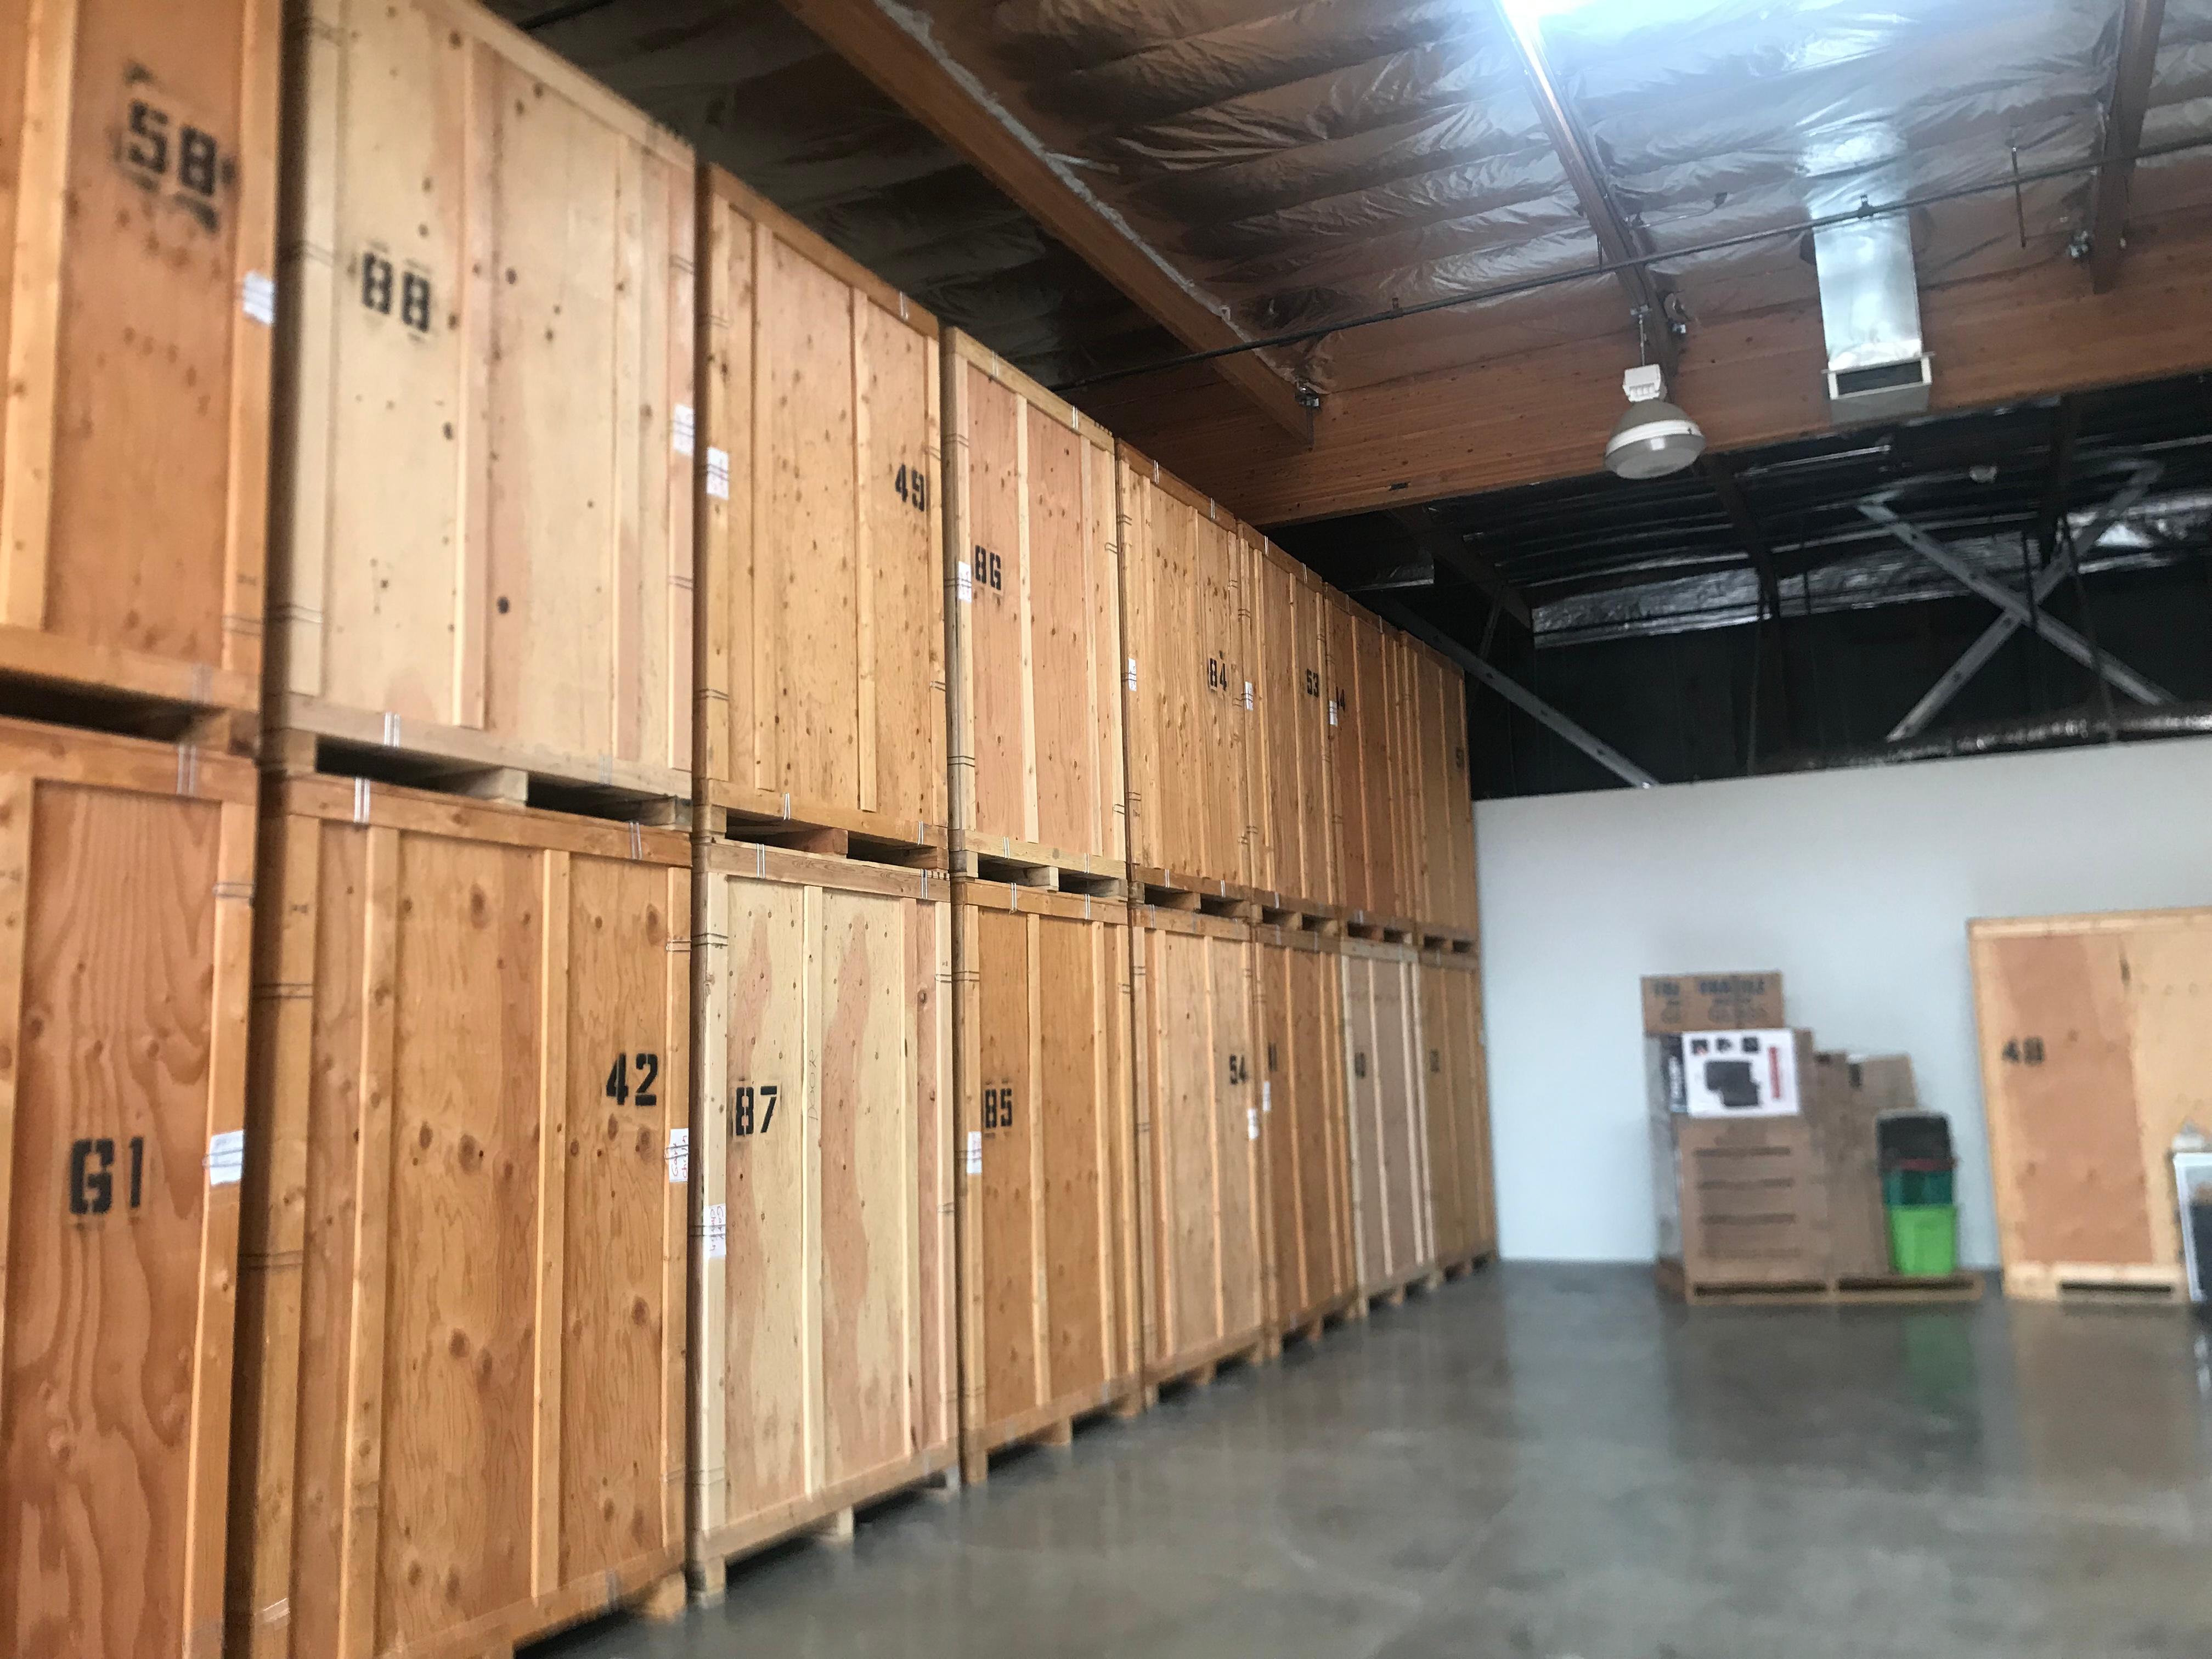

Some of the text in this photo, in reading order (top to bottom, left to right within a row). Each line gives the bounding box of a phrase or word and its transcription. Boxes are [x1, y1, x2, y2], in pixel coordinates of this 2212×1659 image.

[128, 98, 216, 196] 58
[362, 252, 430, 332] 88
[895, 464, 924, 511] 49
[975, 545, 1001, 590] 86
[1209, 658, 1228, 691] 84
[1307, 668, 1319, 698] 53
[606, 1053, 658, 1106] 42
[1229, 1054, 1248, 1085] 54
[736, 1085, 777, 1136] 87
[985, 1088, 1012, 1128] 85
[70, 1136, 144, 1215] 61
